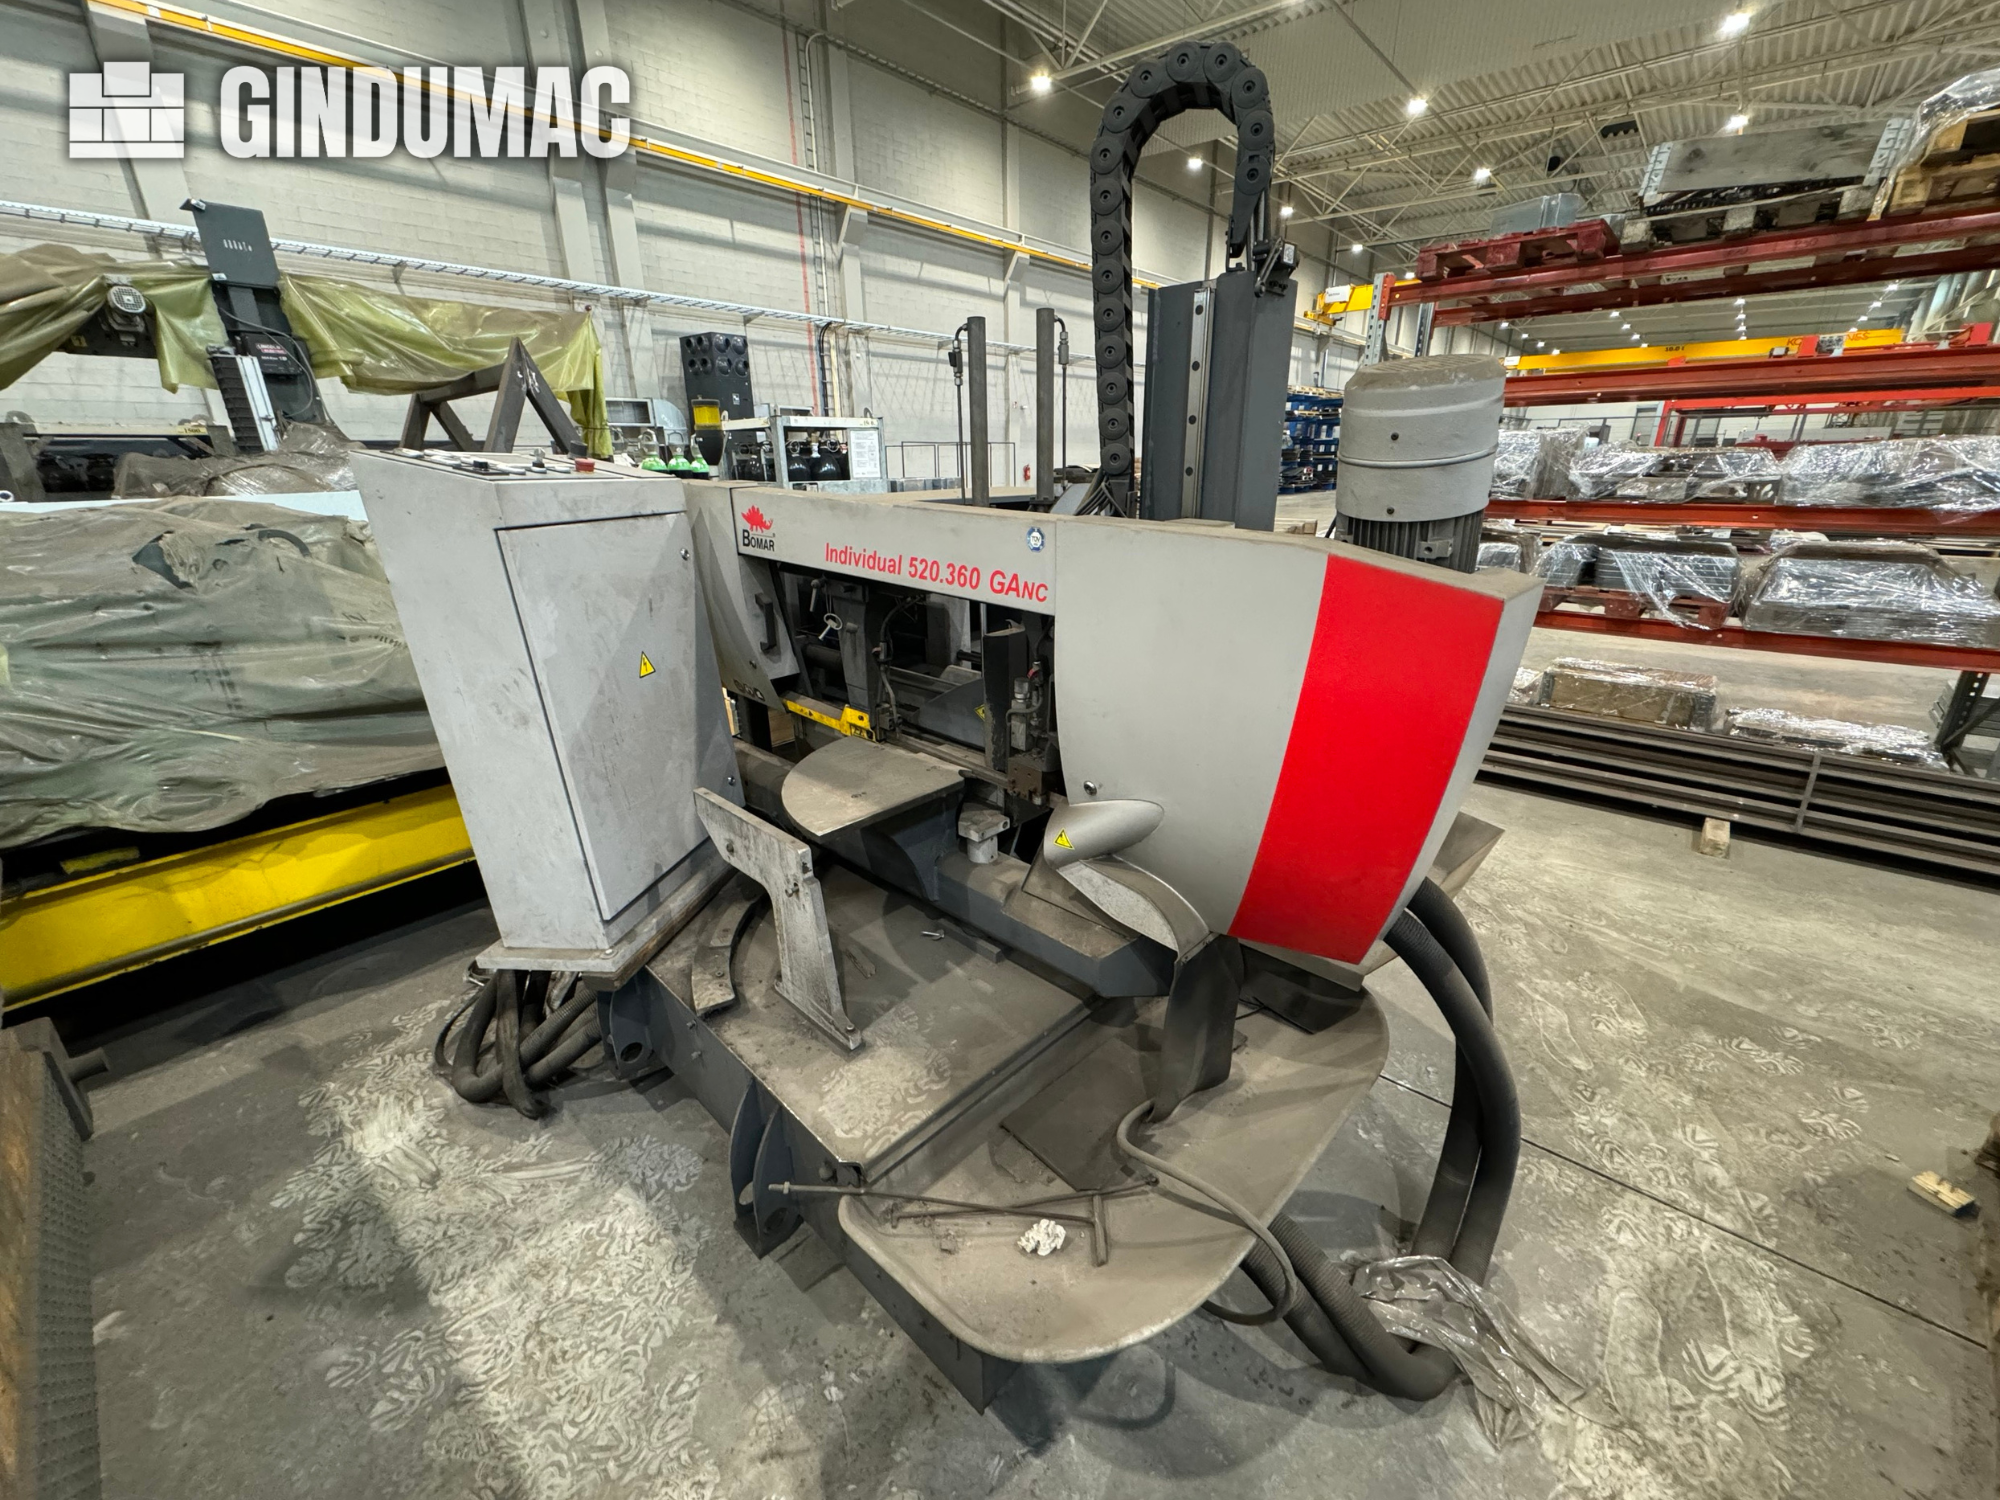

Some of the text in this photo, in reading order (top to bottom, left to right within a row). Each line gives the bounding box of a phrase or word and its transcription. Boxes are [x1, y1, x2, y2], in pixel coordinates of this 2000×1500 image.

[742, 529, 775, 552] BOMAR
[825, 542, 903, 575] Individual
[908, 556, 981, 590] 520.360
